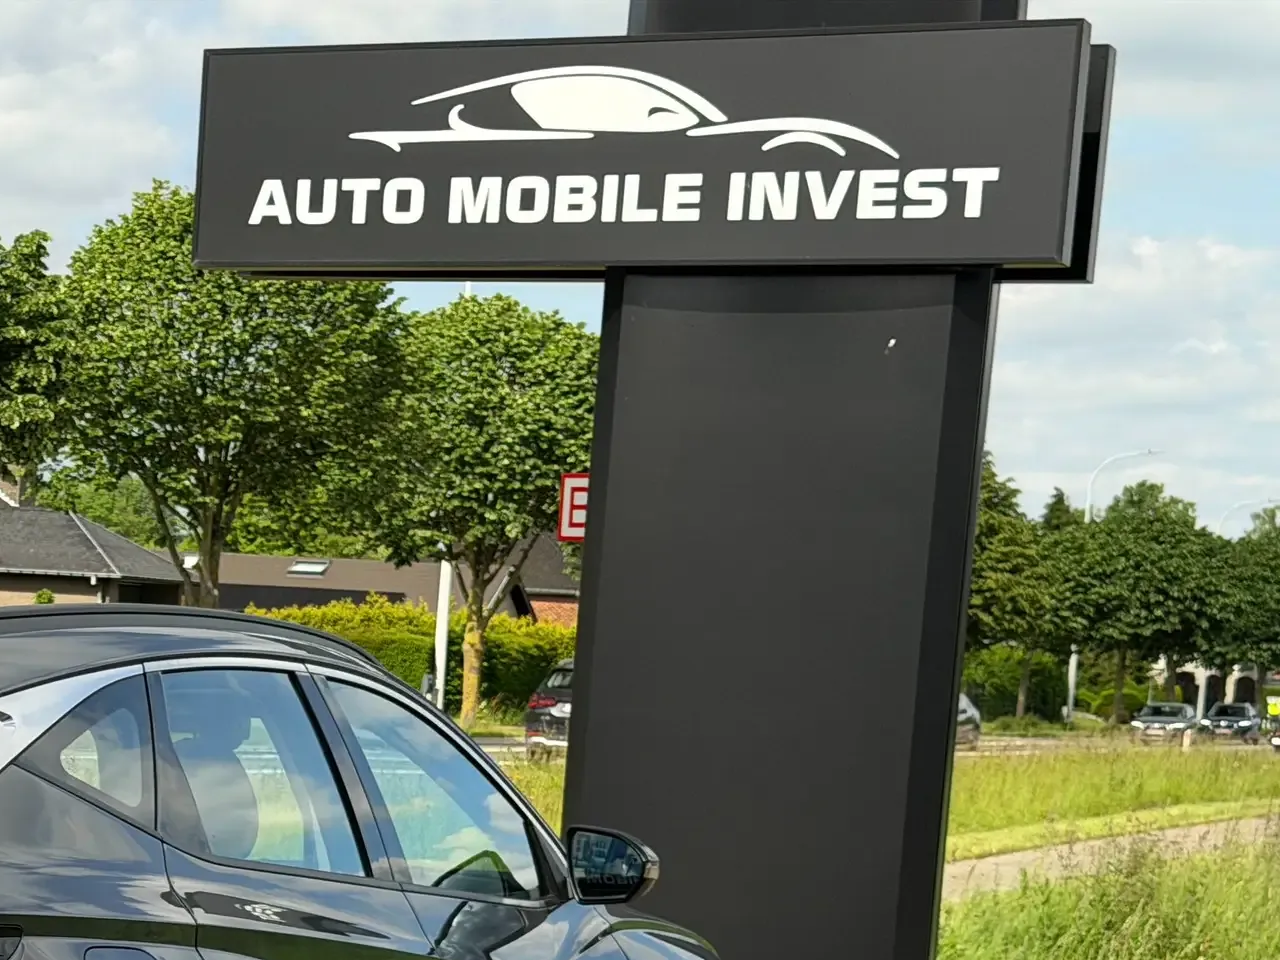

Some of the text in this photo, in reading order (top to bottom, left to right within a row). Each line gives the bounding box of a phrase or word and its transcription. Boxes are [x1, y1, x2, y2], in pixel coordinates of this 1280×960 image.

[248, 166, 1001, 225] AUTO MOBILE INVEST
